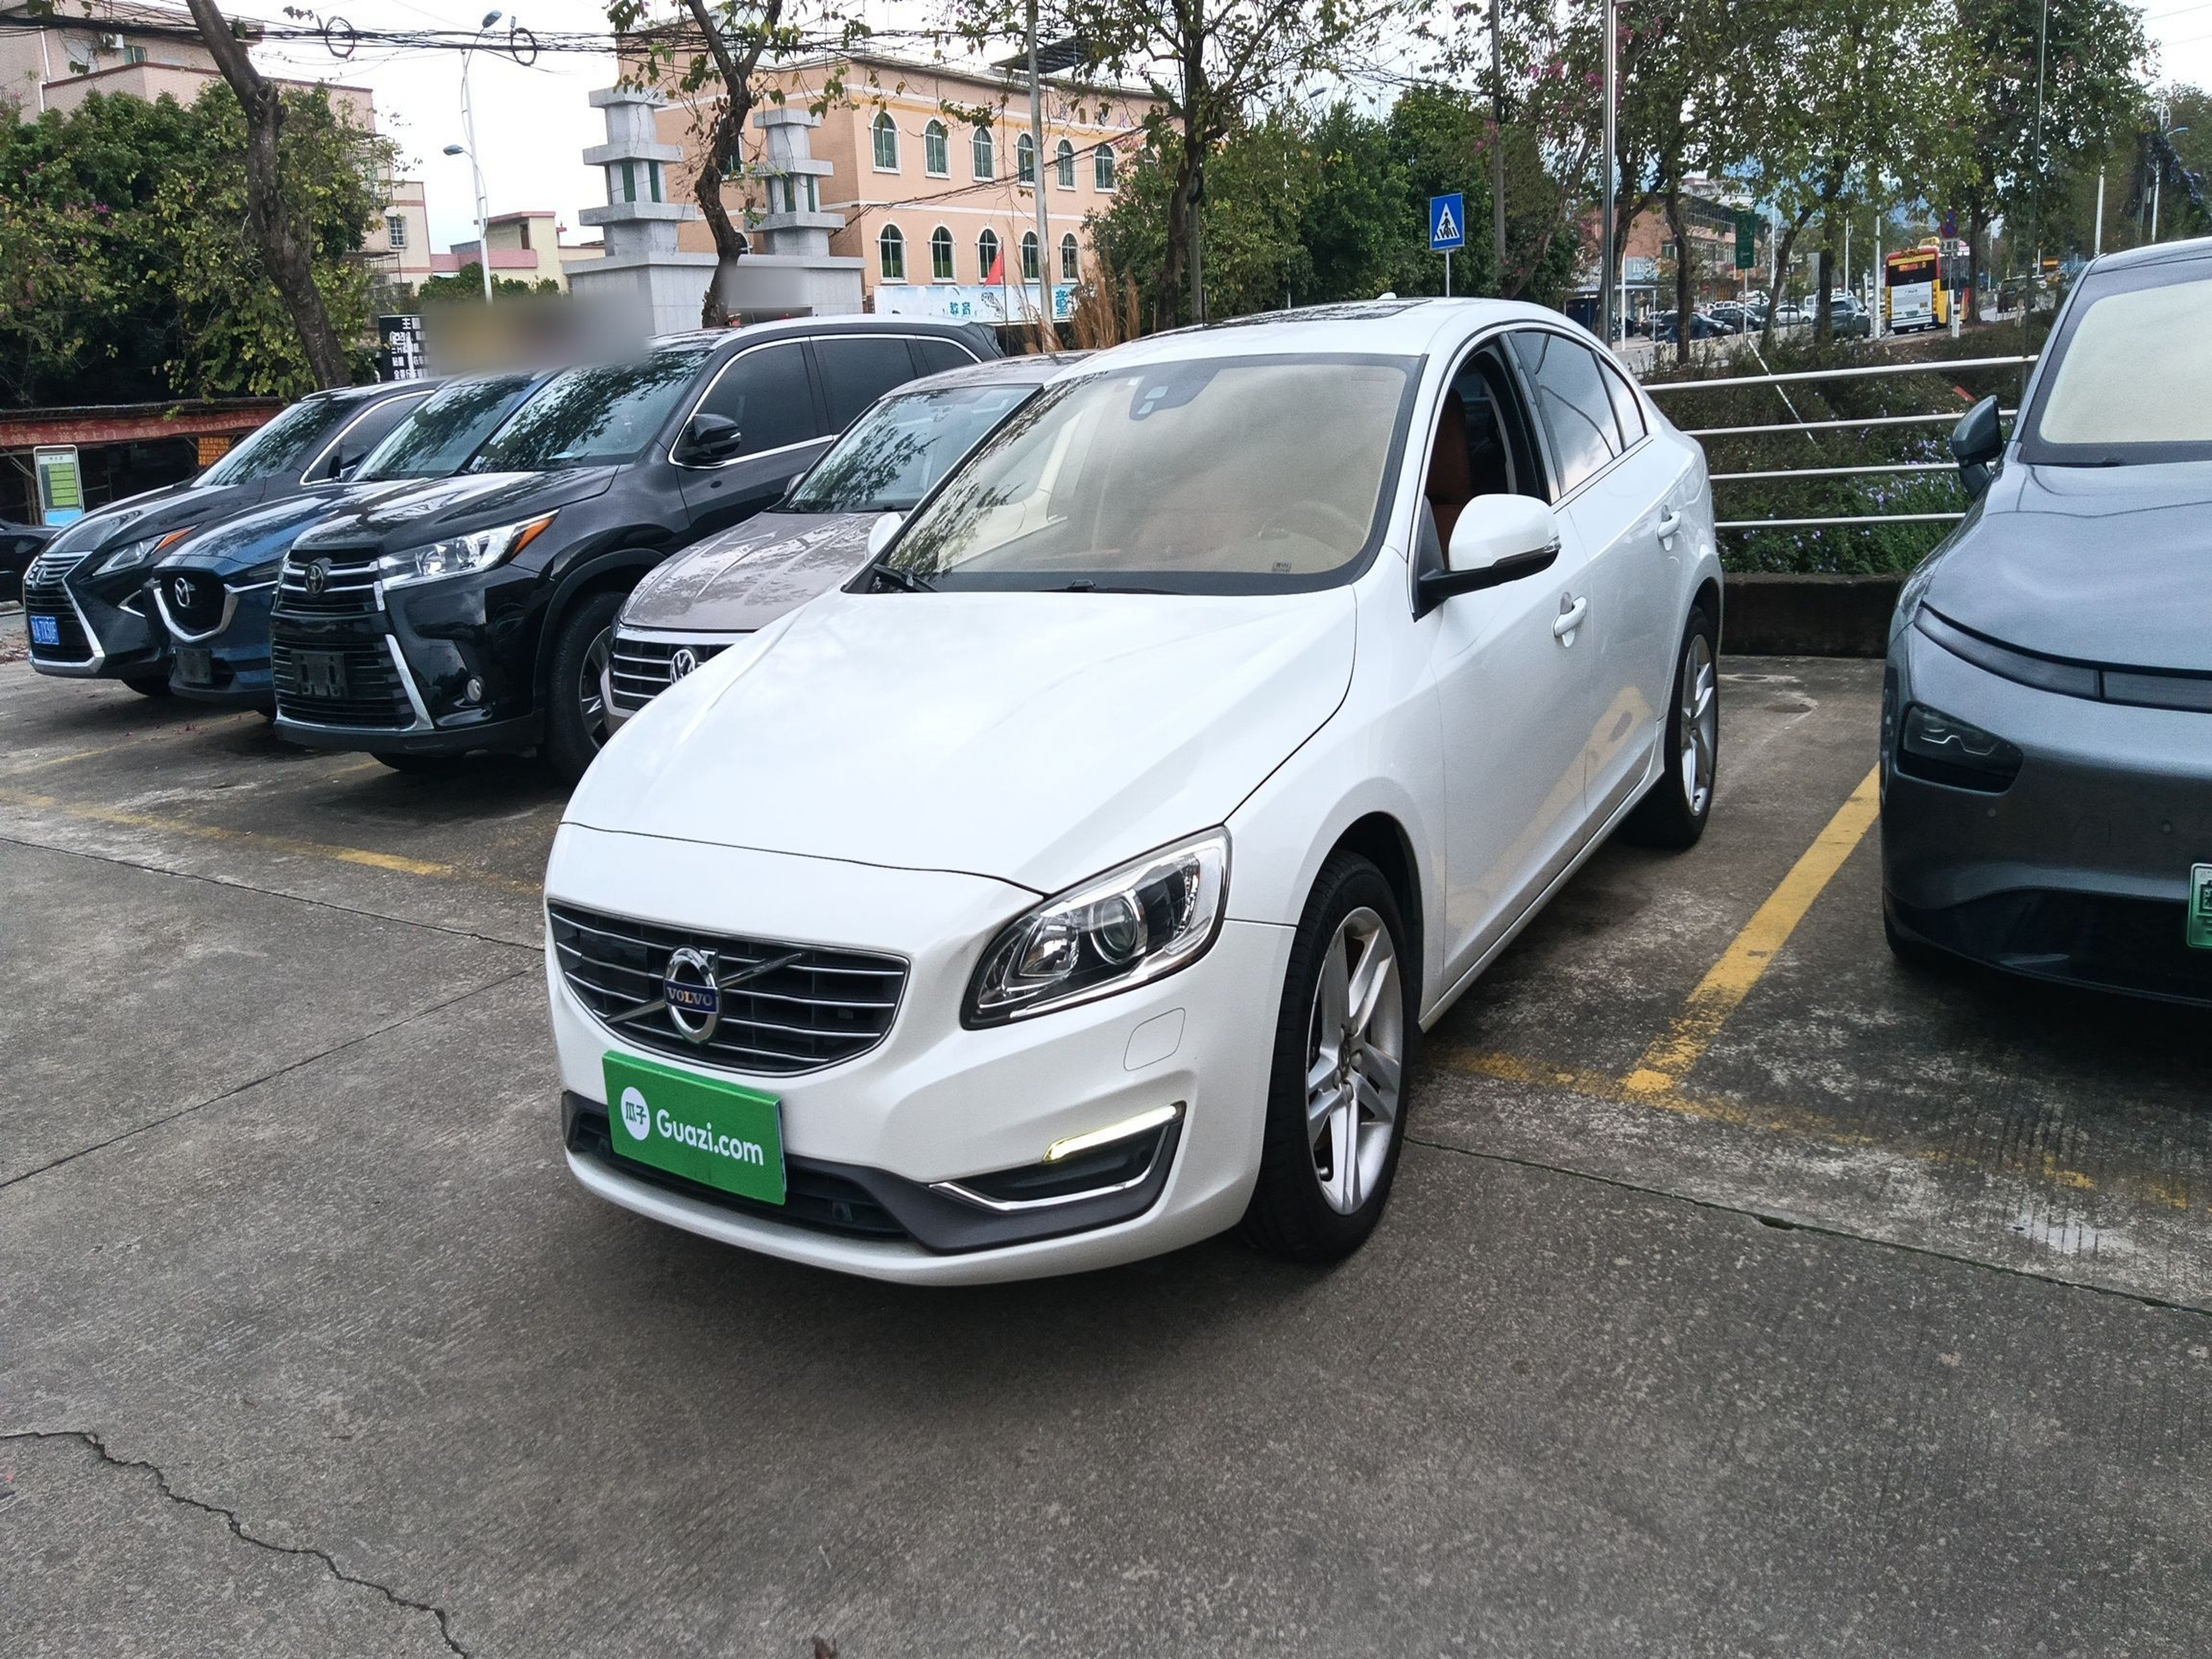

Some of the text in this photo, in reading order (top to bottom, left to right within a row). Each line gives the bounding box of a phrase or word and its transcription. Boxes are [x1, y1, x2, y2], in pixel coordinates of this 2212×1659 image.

[666, 986, 713, 1006] VOLVO
[626, 1101, 646, 1125] 瓜子
[657, 1109, 764, 1166] Guazi.com
